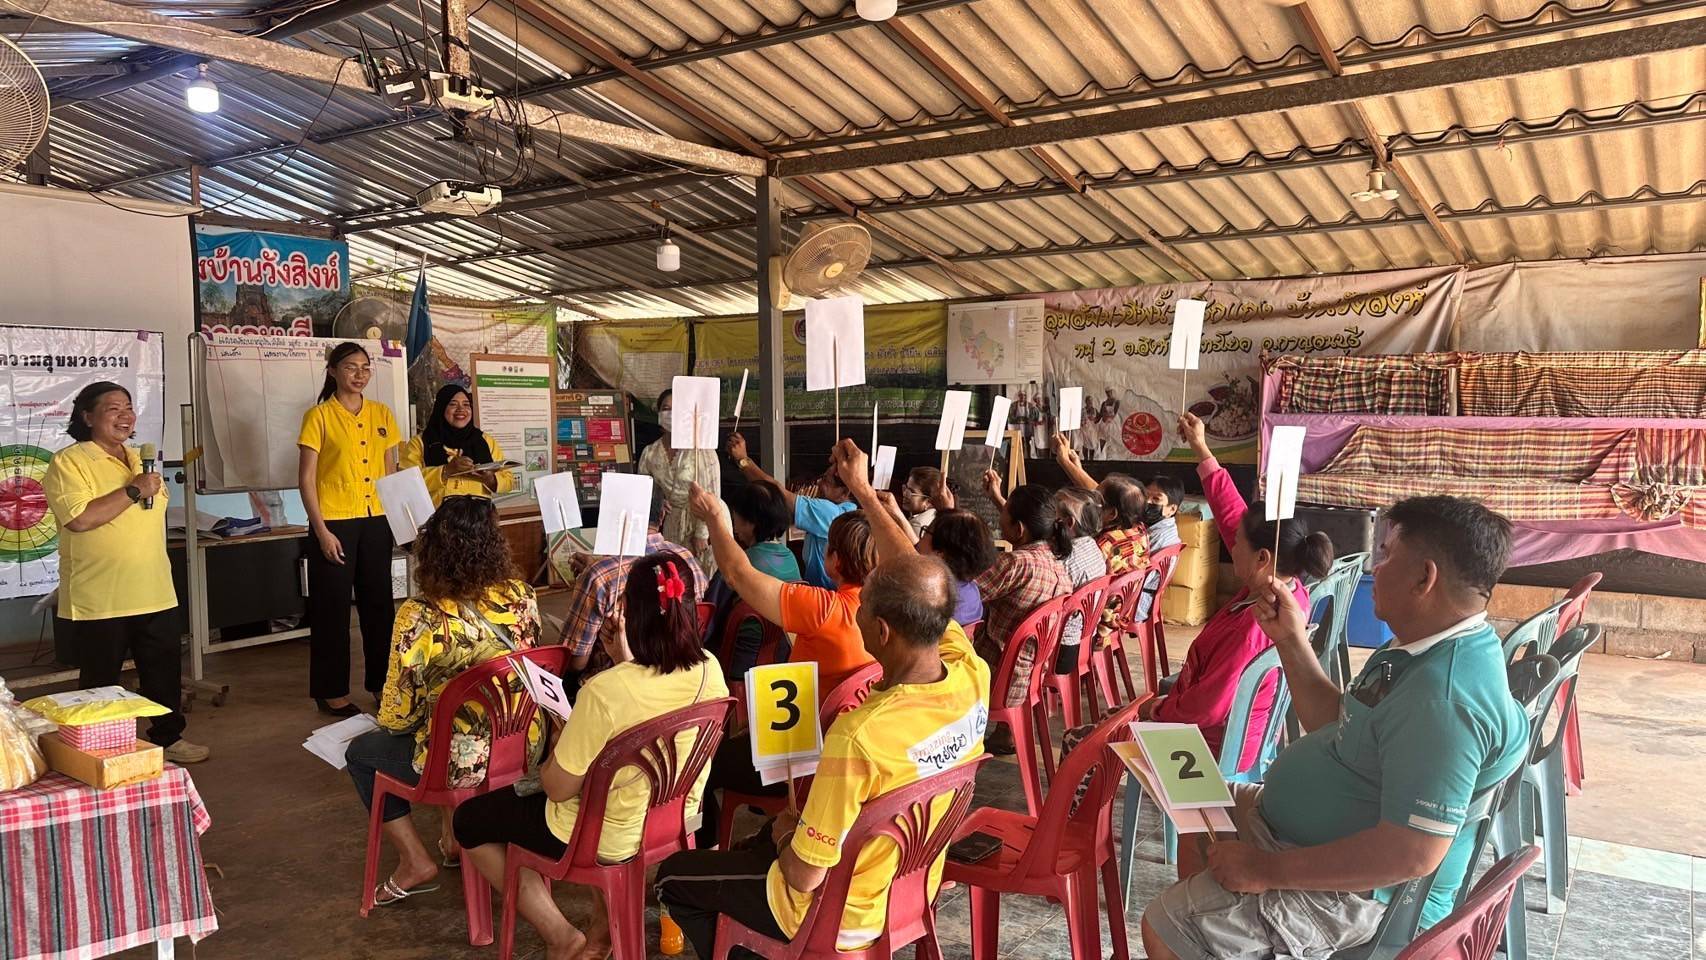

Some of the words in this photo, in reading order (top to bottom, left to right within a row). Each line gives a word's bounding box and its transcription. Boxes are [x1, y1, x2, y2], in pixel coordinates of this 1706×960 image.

[1102, 337, 1117, 356] 2
[539, 674, 560, 702] 5
[770, 679, 800, 731] 3
[1170, 750, 1205, 780] 2
[815, 832, 837, 846] SCG
